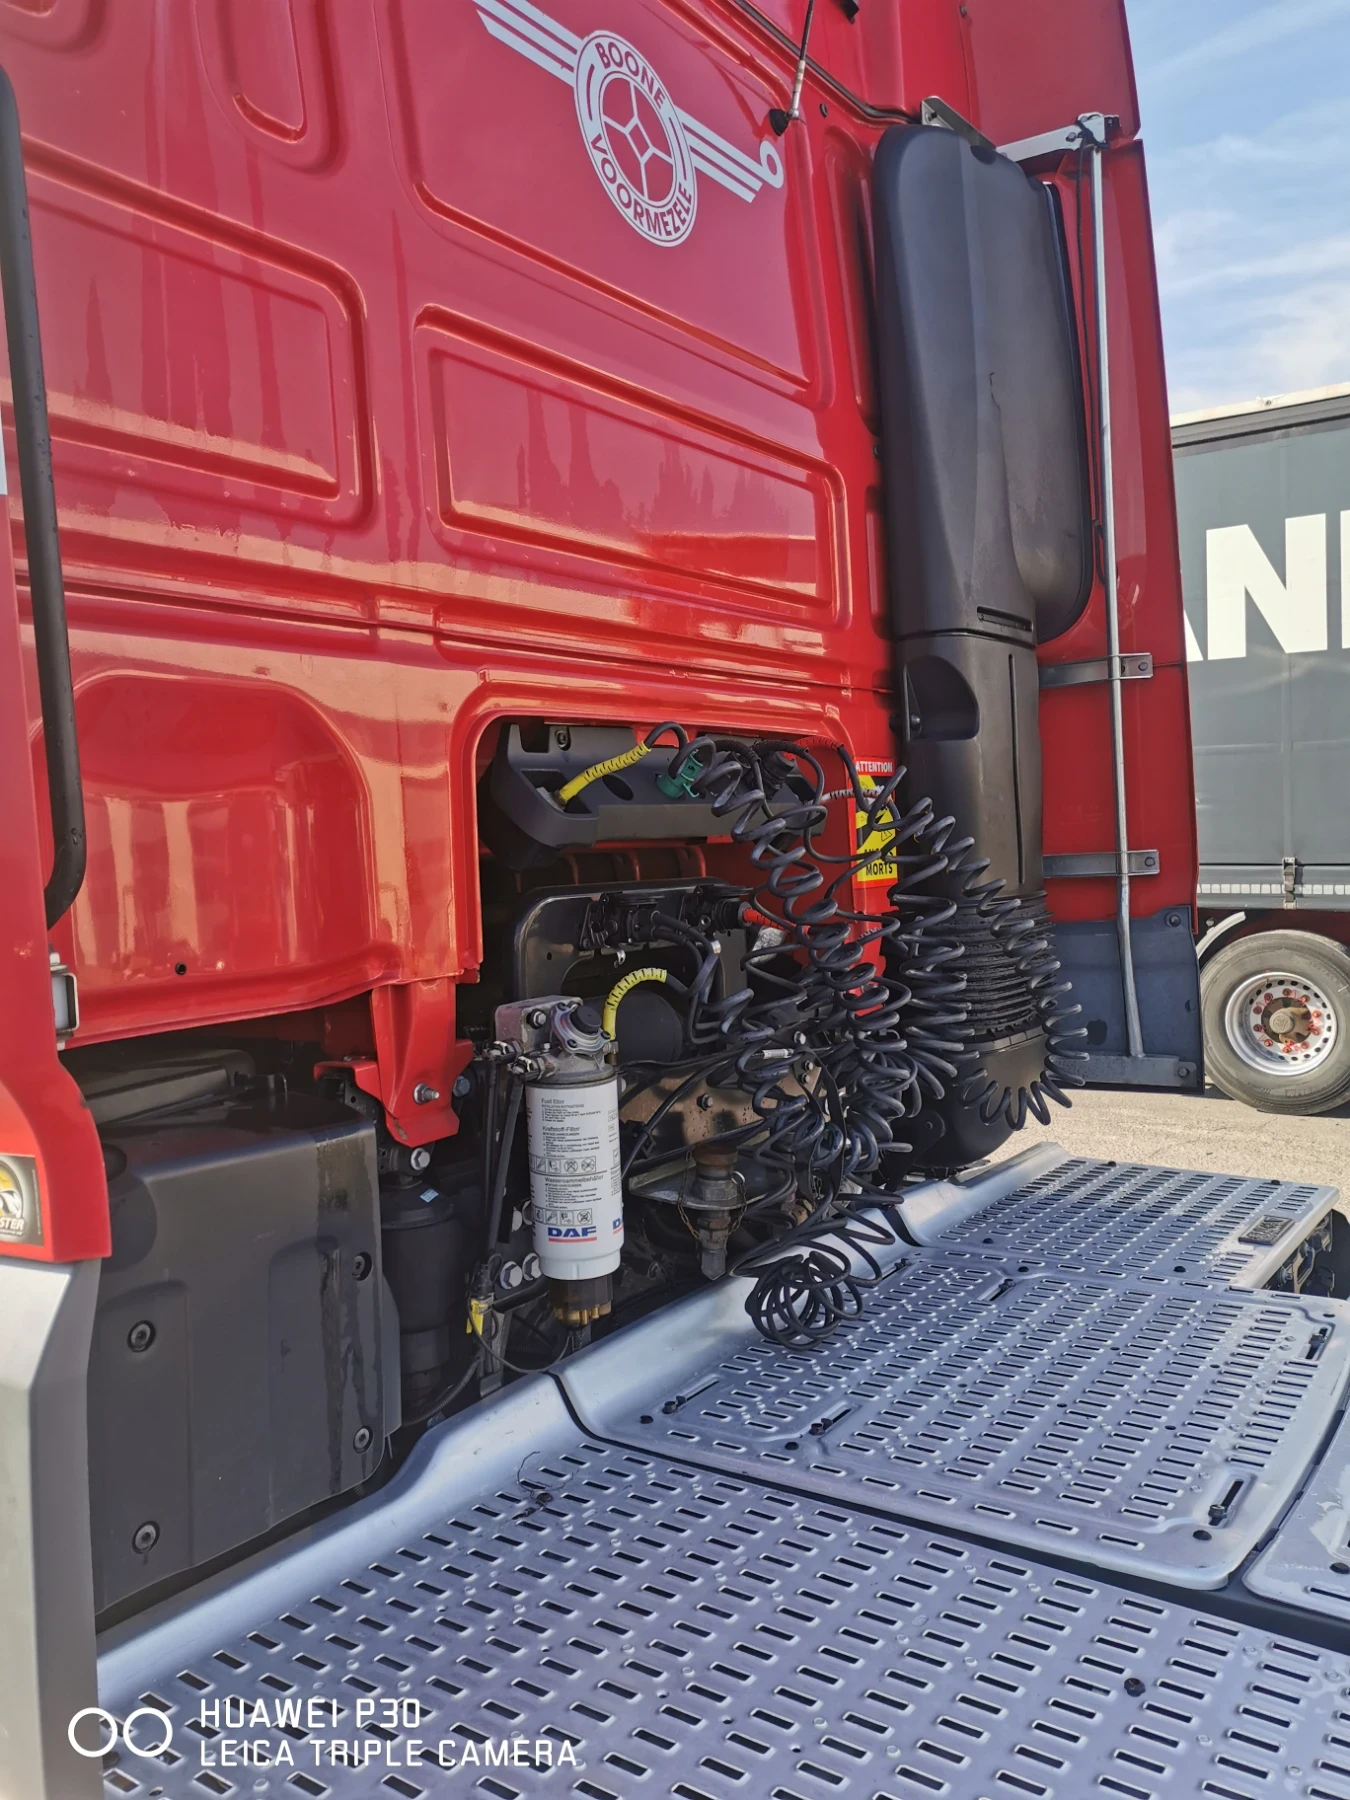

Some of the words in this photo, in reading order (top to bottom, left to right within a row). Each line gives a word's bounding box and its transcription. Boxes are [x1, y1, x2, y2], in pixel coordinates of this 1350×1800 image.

[594, 42, 665, 109] BOONE
[590, 134, 692, 238] VOORMEZELE
[855, 760, 893, 773] ATTENTION
[866, 862, 893, 876] MORTS
[547, 1225, 597, 1237] DAF
